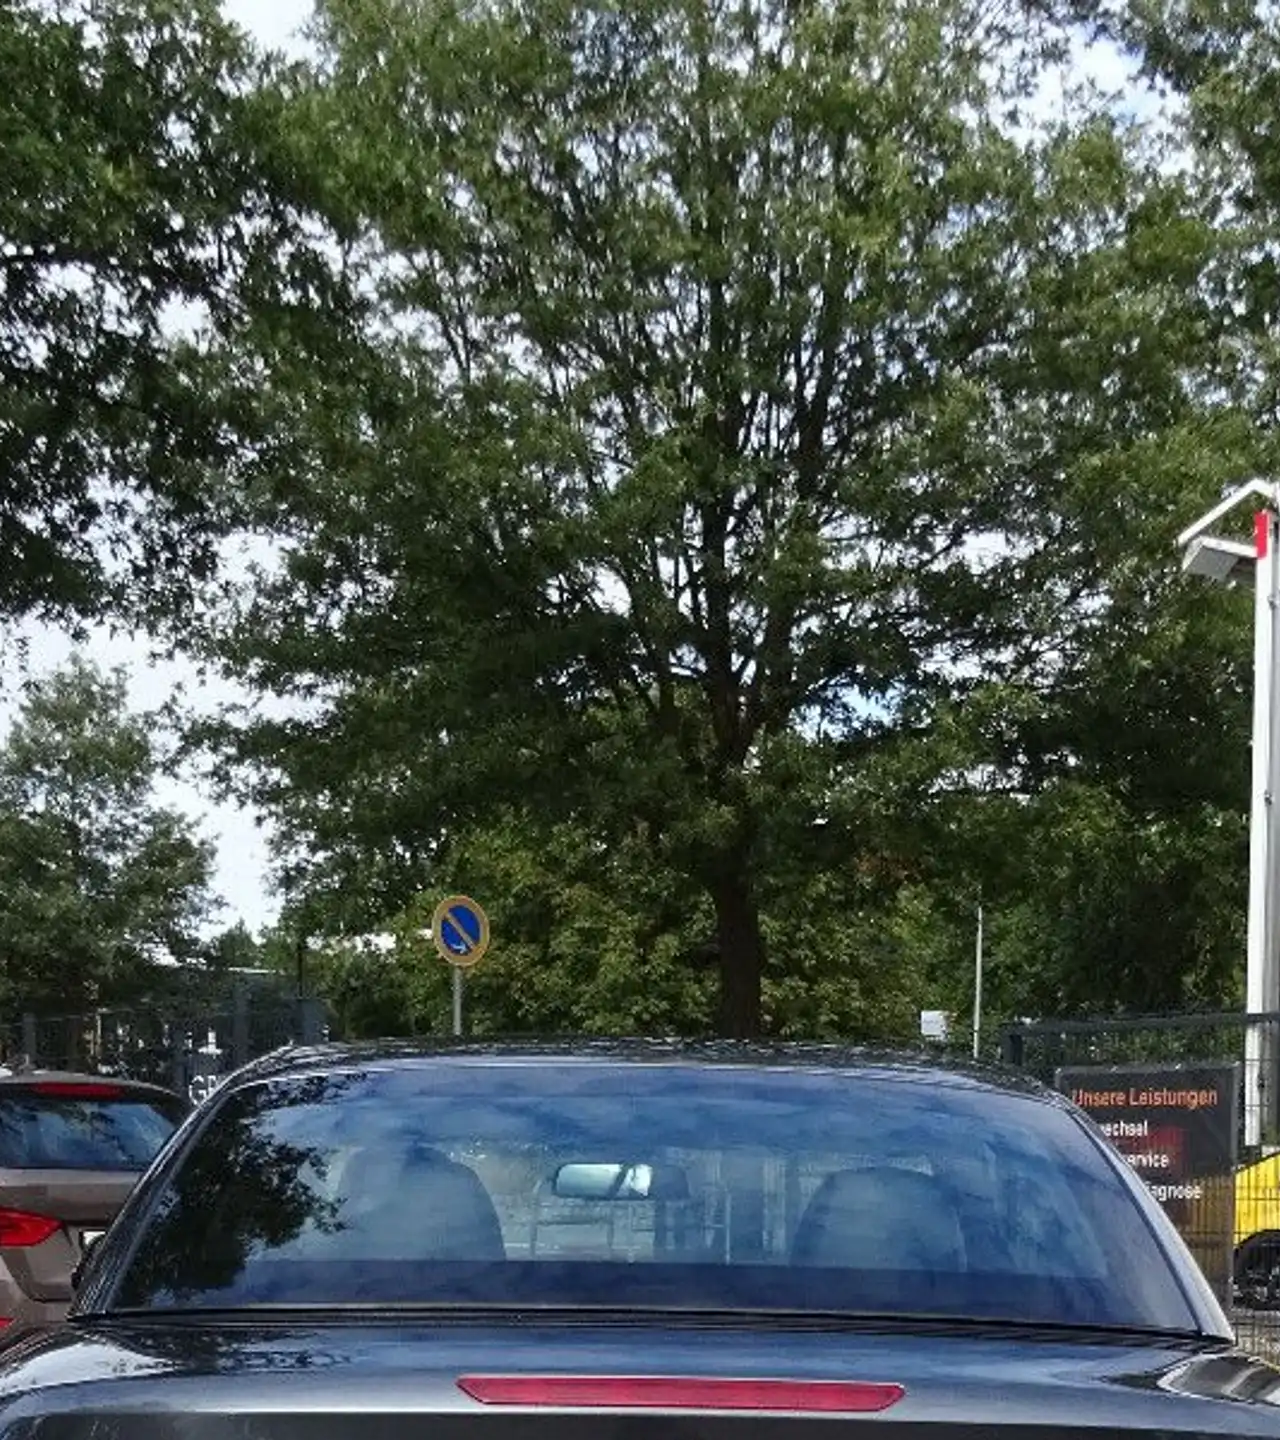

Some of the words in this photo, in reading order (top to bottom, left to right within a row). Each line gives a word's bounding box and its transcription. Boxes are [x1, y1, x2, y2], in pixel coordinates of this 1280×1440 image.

[1071, 1088, 1125, 1106] Unsere
[1129, 1087, 1218, 1109] Leistungen
[1125, 1150, 1170, 1169] ervice
